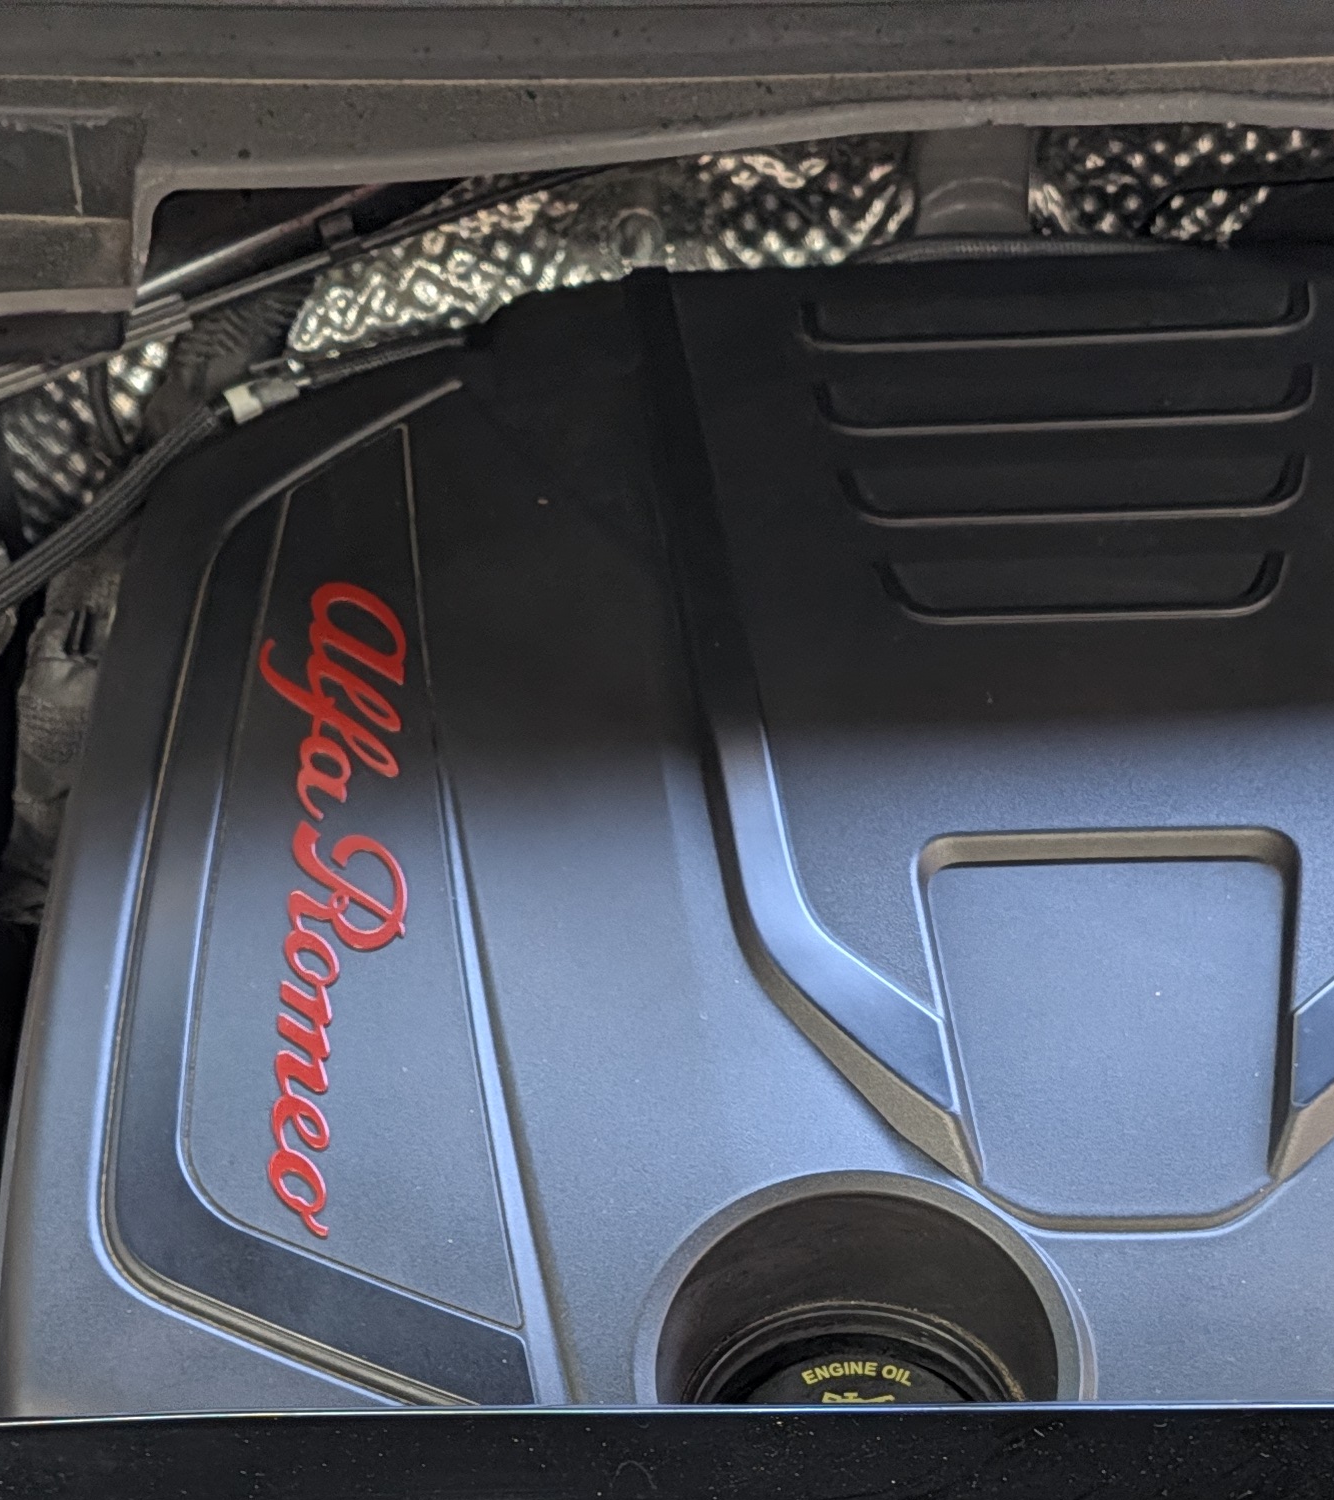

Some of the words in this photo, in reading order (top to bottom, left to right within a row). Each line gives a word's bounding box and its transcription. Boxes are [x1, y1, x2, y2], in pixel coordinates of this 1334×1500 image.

[259, 581, 407, 822] Alfa
[268, 821, 408, 1238] Romeo
[801, 1361, 879, 1385] ENGINE
[881, 1364, 912, 1387] OIL
